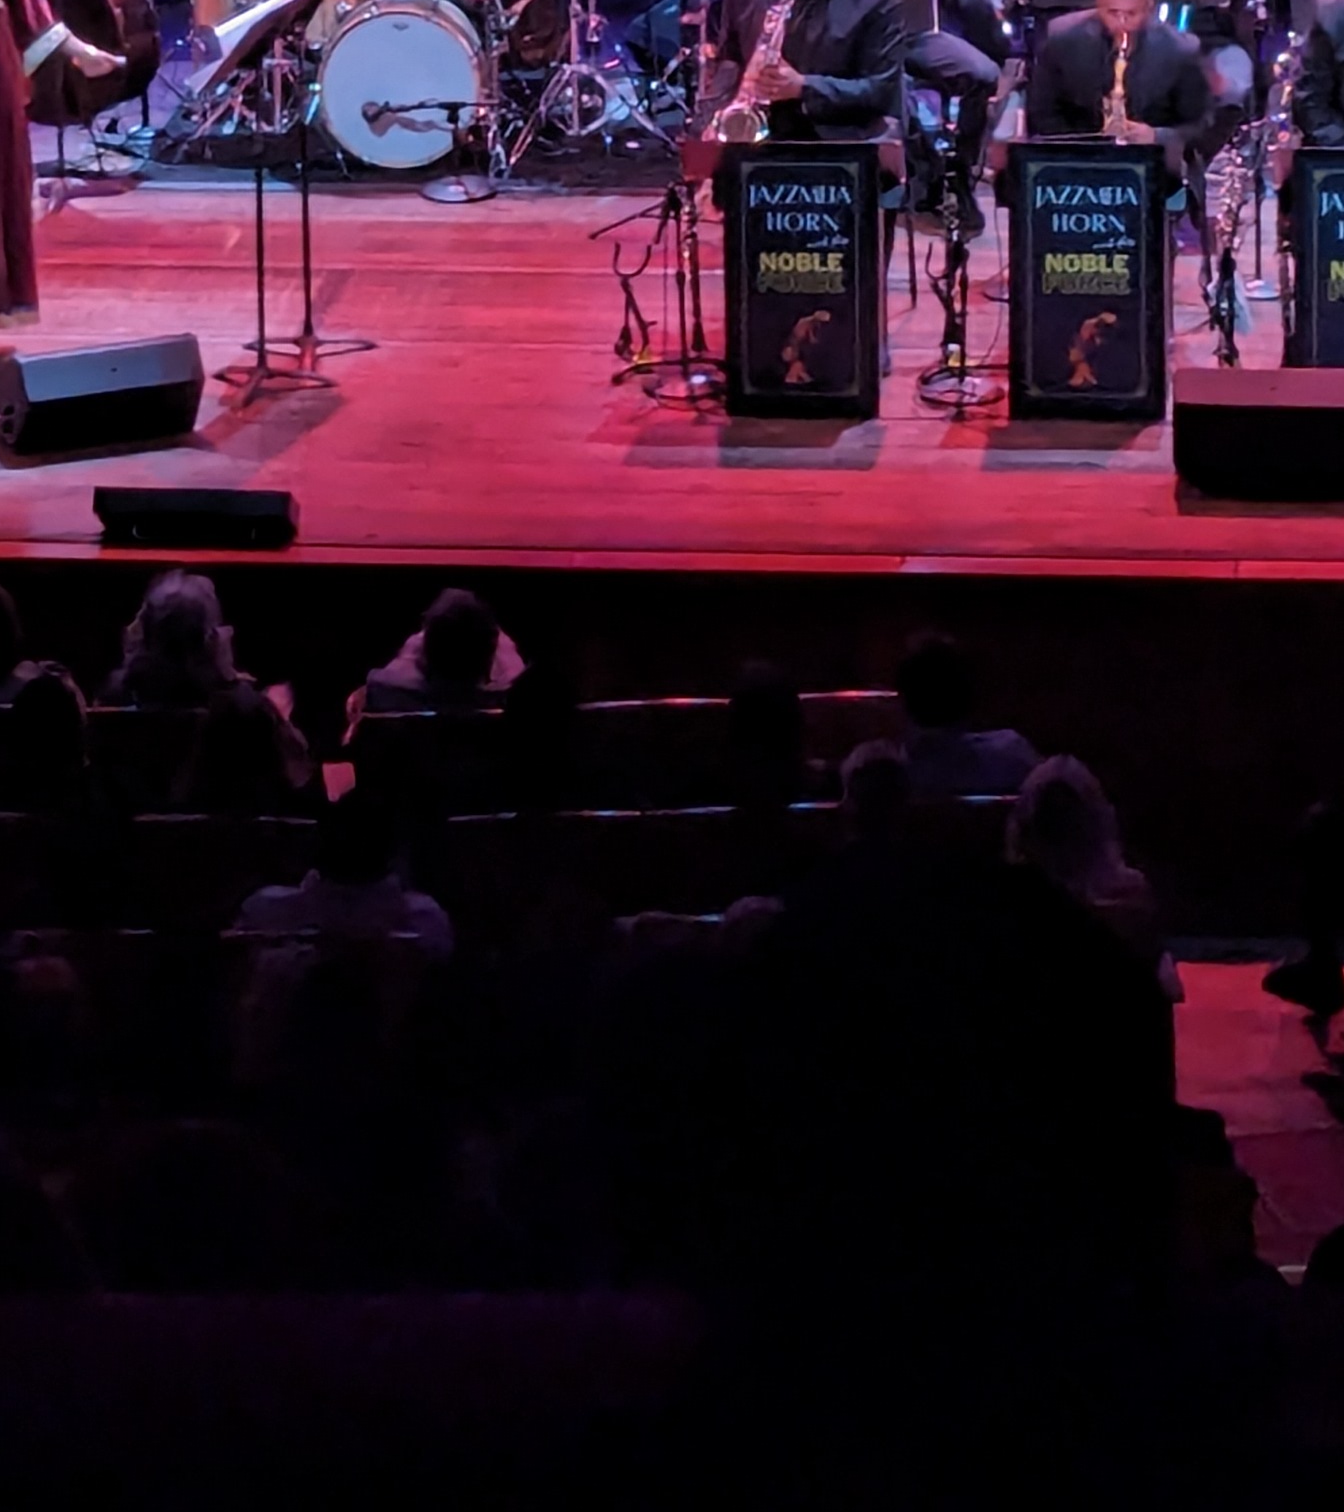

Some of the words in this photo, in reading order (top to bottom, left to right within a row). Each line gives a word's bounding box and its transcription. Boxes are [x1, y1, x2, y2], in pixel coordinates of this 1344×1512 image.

[765, 211, 842, 232] HORN
[1051, 212, 1126, 233] HORN
[758, 251, 844, 272] NOBLE
[1044, 253, 1130, 273] NOBLE
